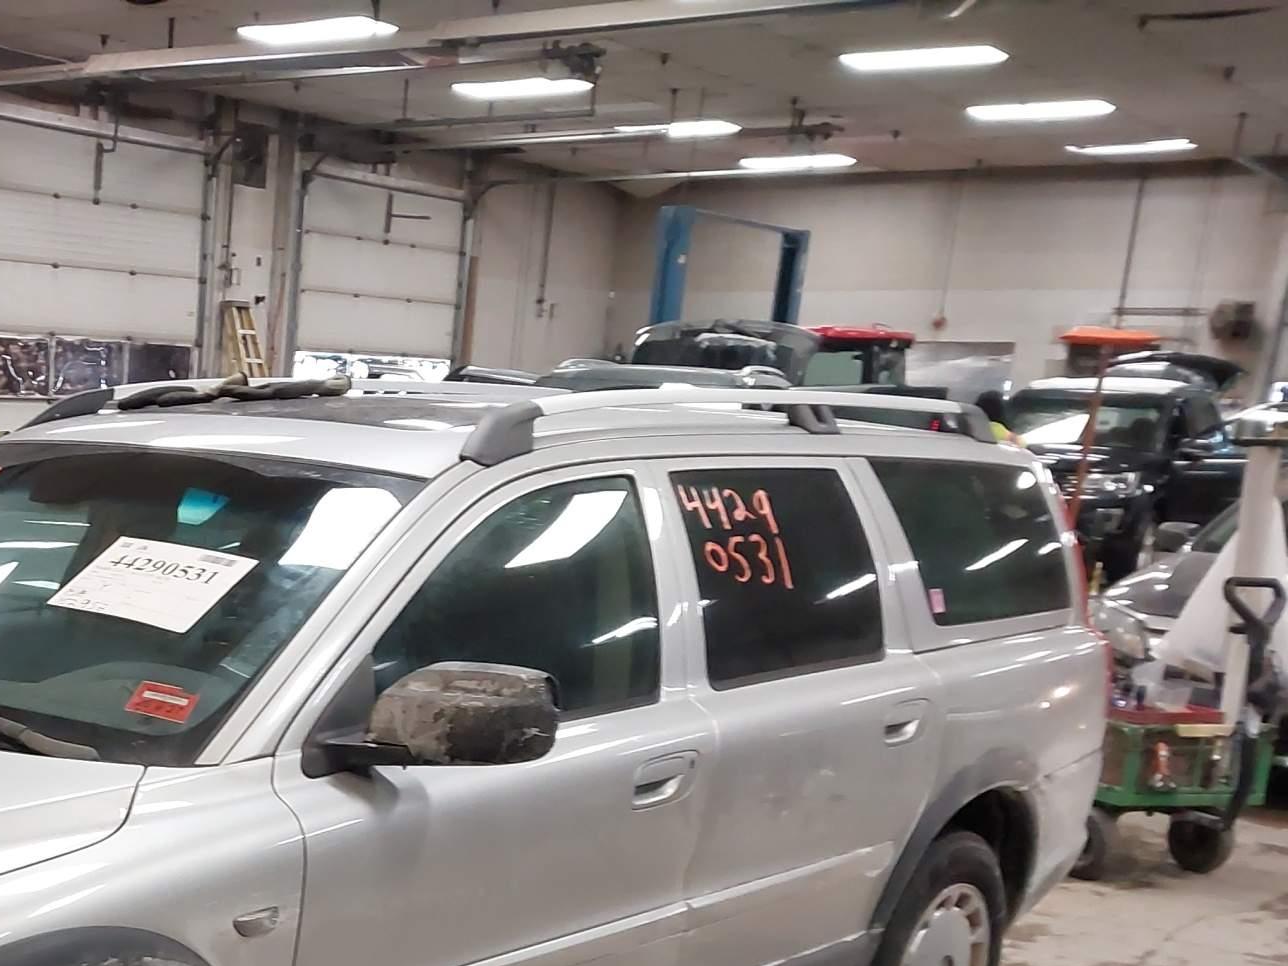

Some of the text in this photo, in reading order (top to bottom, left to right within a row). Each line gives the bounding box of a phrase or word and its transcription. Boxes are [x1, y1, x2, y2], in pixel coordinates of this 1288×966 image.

[677, 484, 779, 534] 4429
[110, 554, 220, 585] 44290531
[703, 533, 794, 589] 0531
